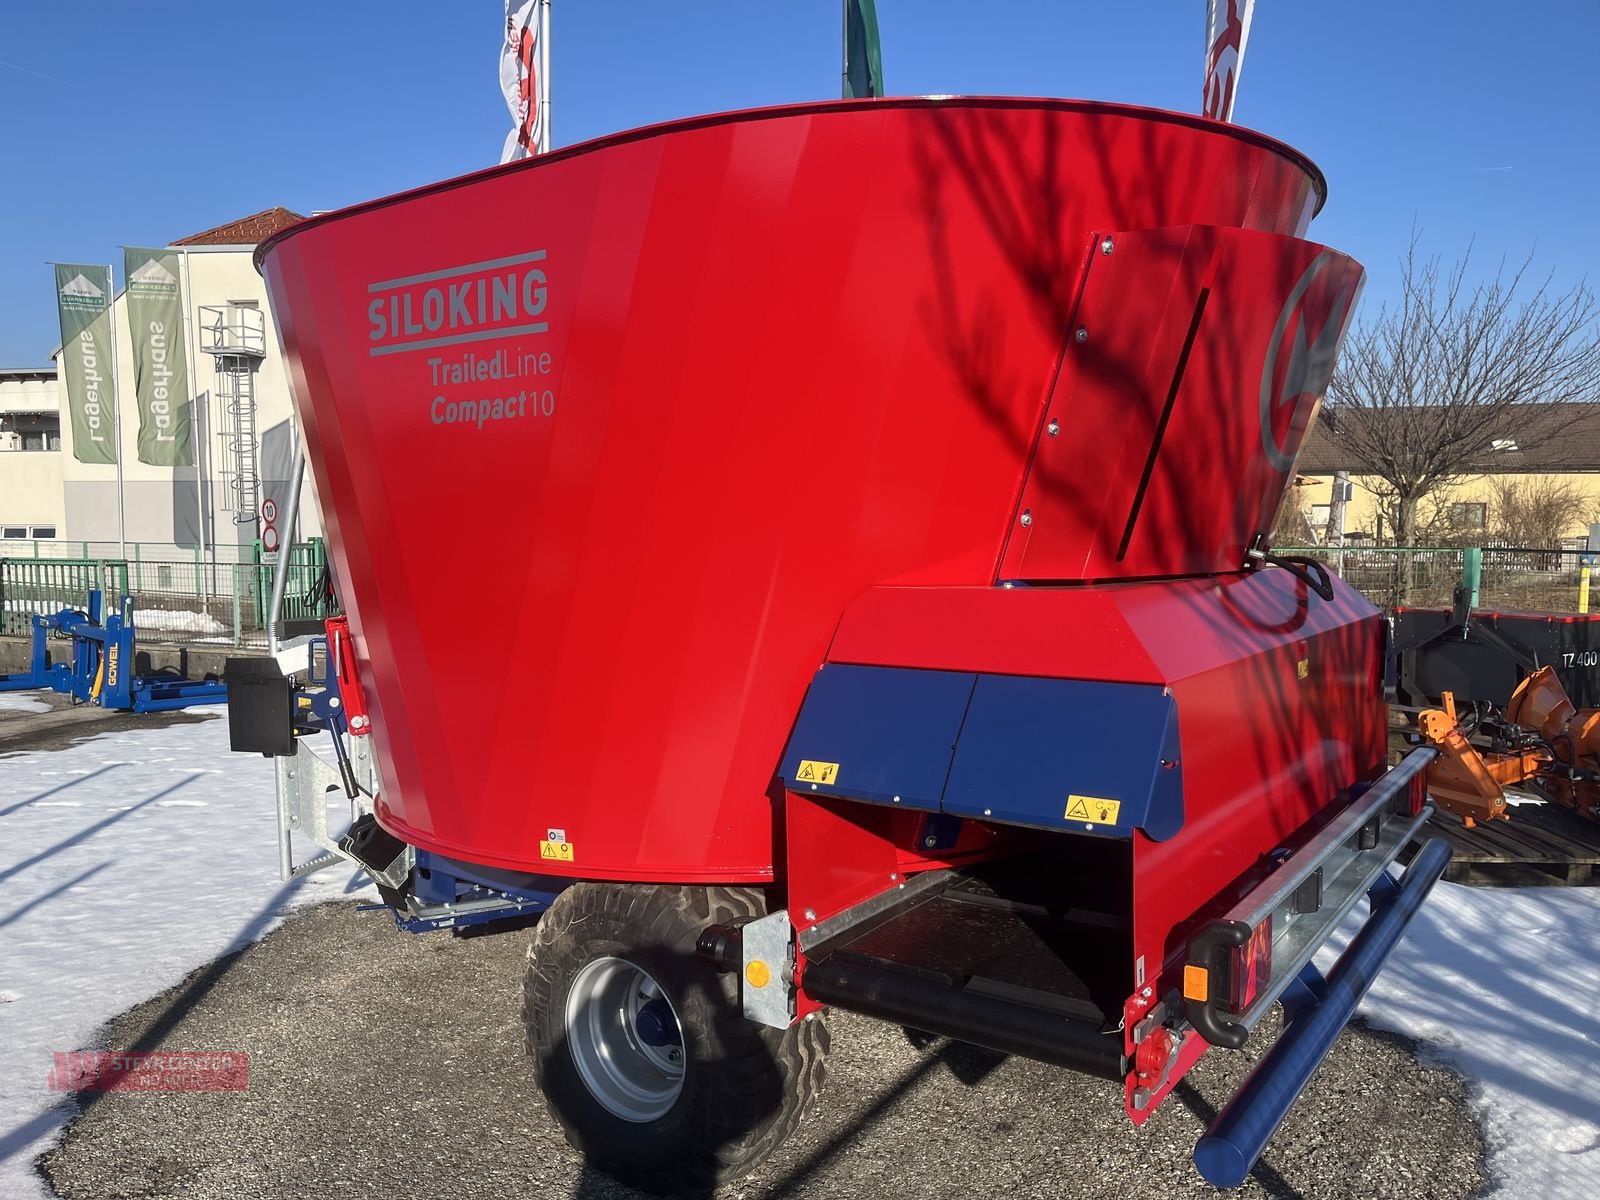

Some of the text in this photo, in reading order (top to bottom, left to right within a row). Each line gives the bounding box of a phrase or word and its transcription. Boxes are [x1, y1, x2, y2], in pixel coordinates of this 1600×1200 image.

[368, 269, 548, 341] SILOKING
[427, 347, 551, 386] TrailedLine
[266, 505, 274, 518] 10
[1562, 651, 1598, 669] TZ 400
